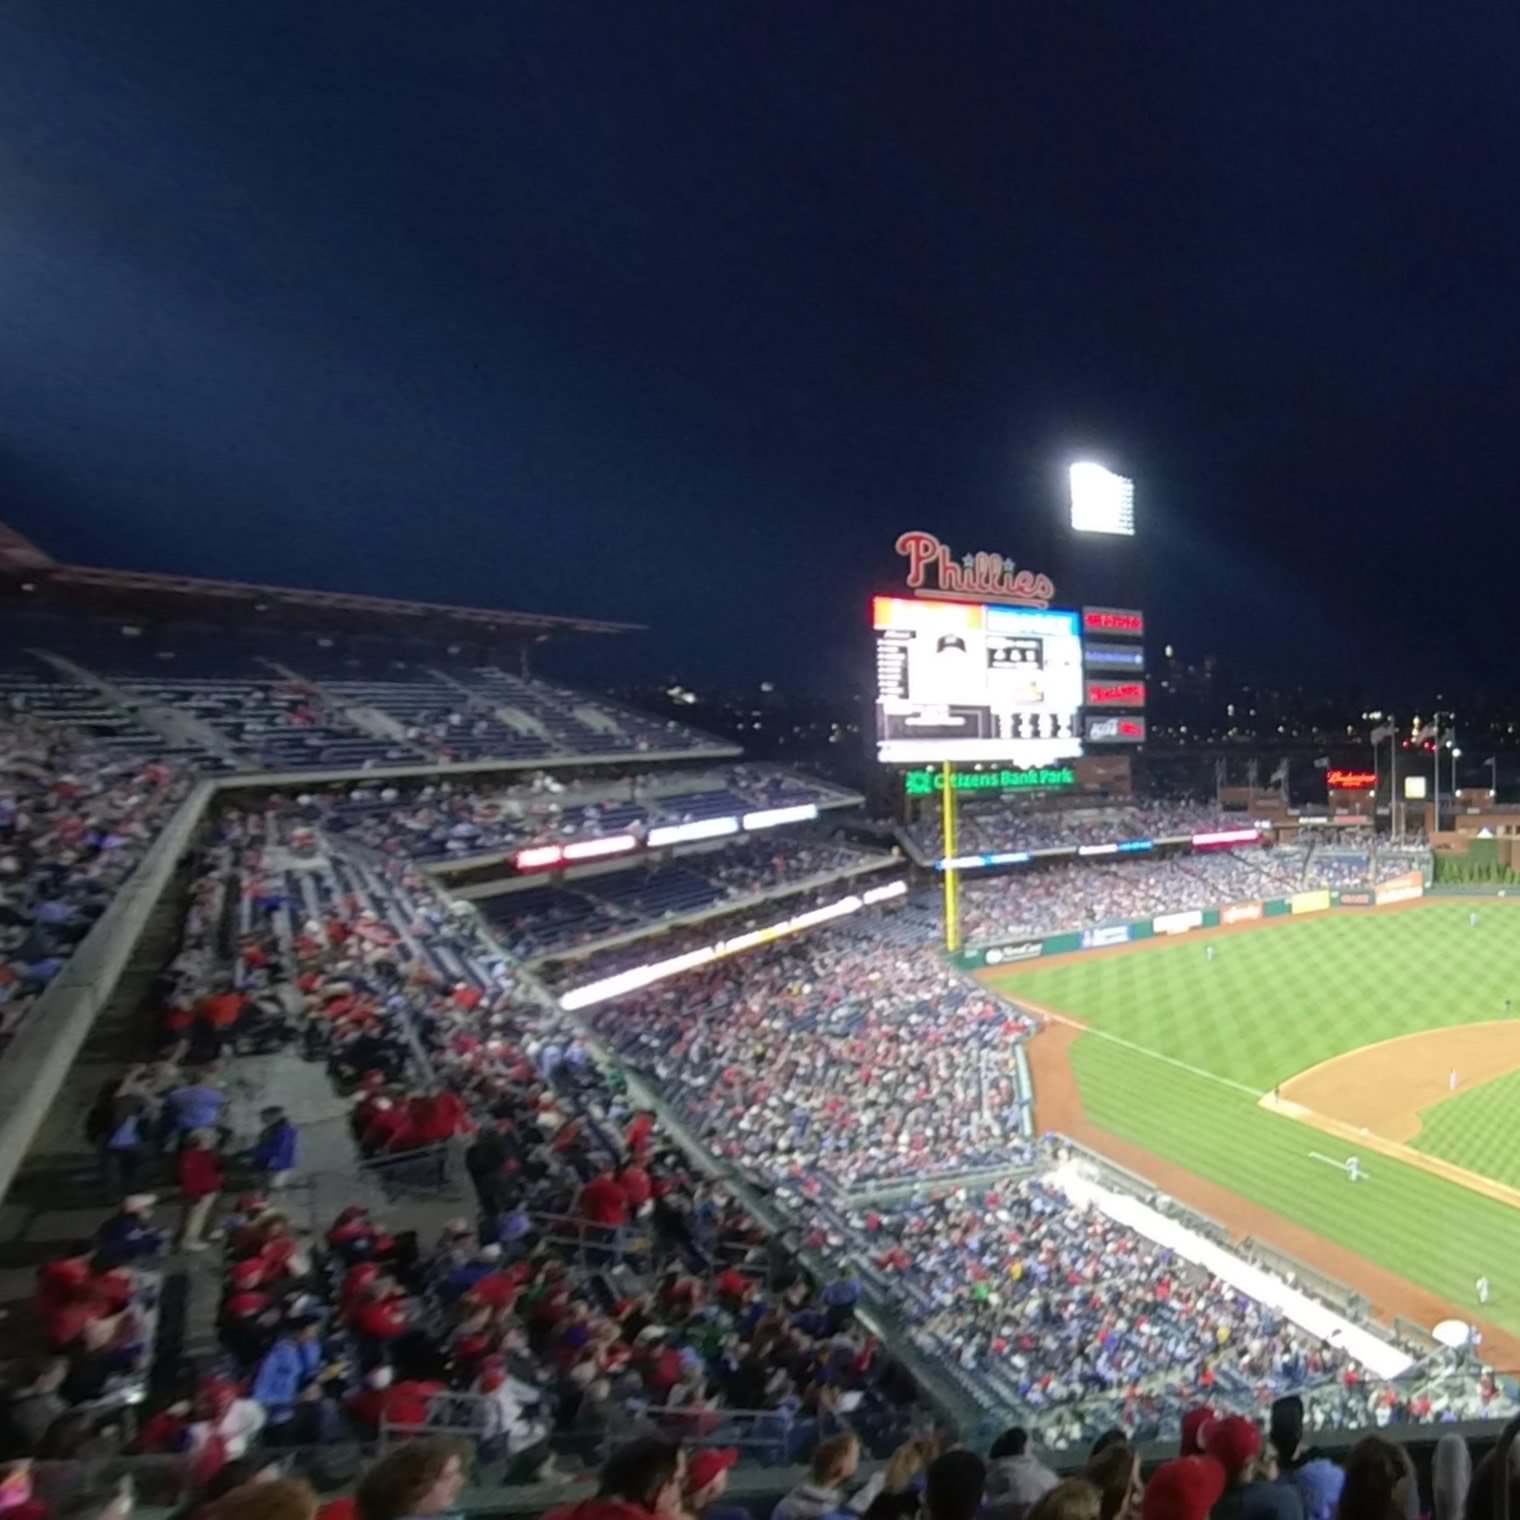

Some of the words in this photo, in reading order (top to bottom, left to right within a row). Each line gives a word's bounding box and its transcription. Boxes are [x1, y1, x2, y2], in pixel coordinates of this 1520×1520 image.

[895, 530, 1055, 600] Phillies
[933, 771, 998, 789] Ctizens
[1000, 769, 1038, 786] Bank
[1039, 767, 1074, 784] Park
